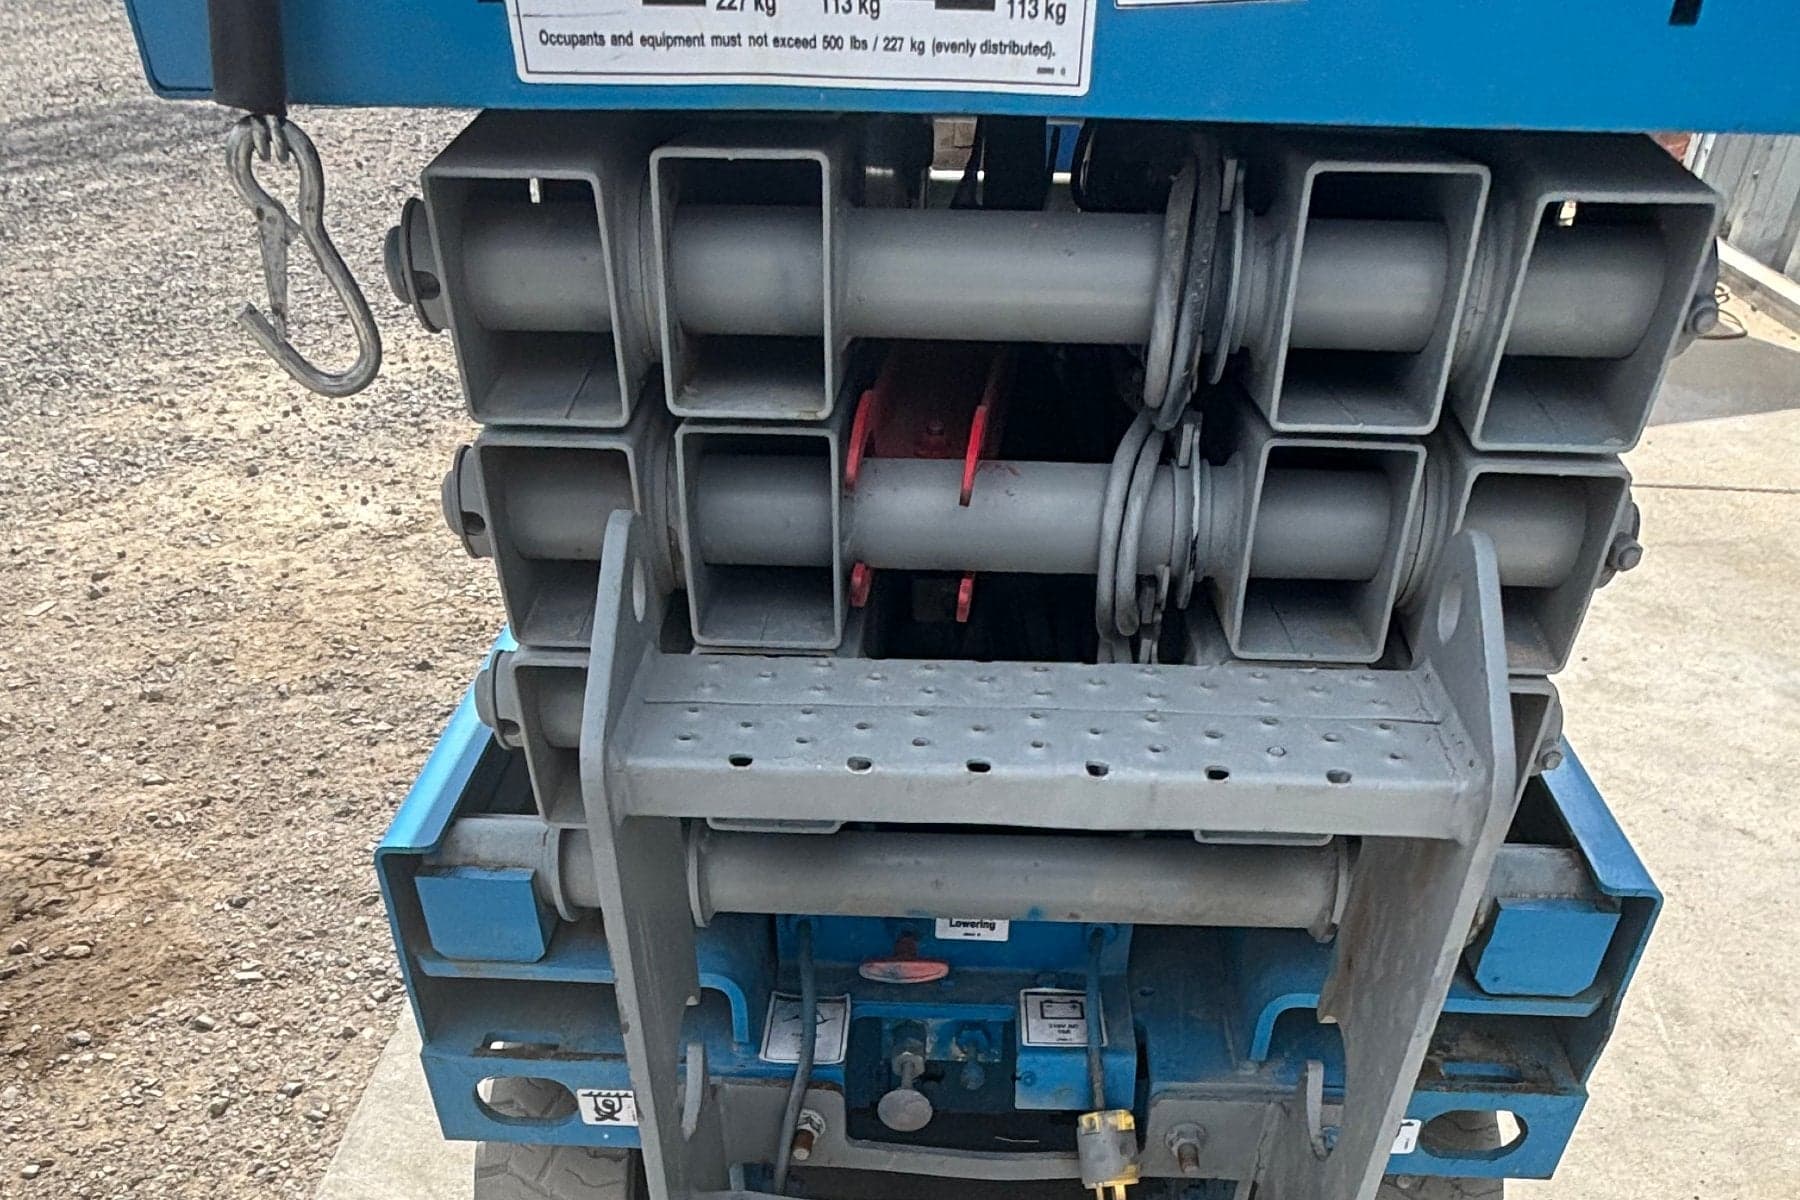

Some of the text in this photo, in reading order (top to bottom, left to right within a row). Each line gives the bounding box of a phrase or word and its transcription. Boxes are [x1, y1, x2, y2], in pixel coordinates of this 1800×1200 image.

[823, 0, 880, 21] 113 kg
[1006, 0, 1067, 26] 113 kg
[539, 29, 1056, 59] Occupants and equipment must not exceed 500 lbs / 227 kg (evenly distributed).
[949, 918, 996, 931] Lowering
